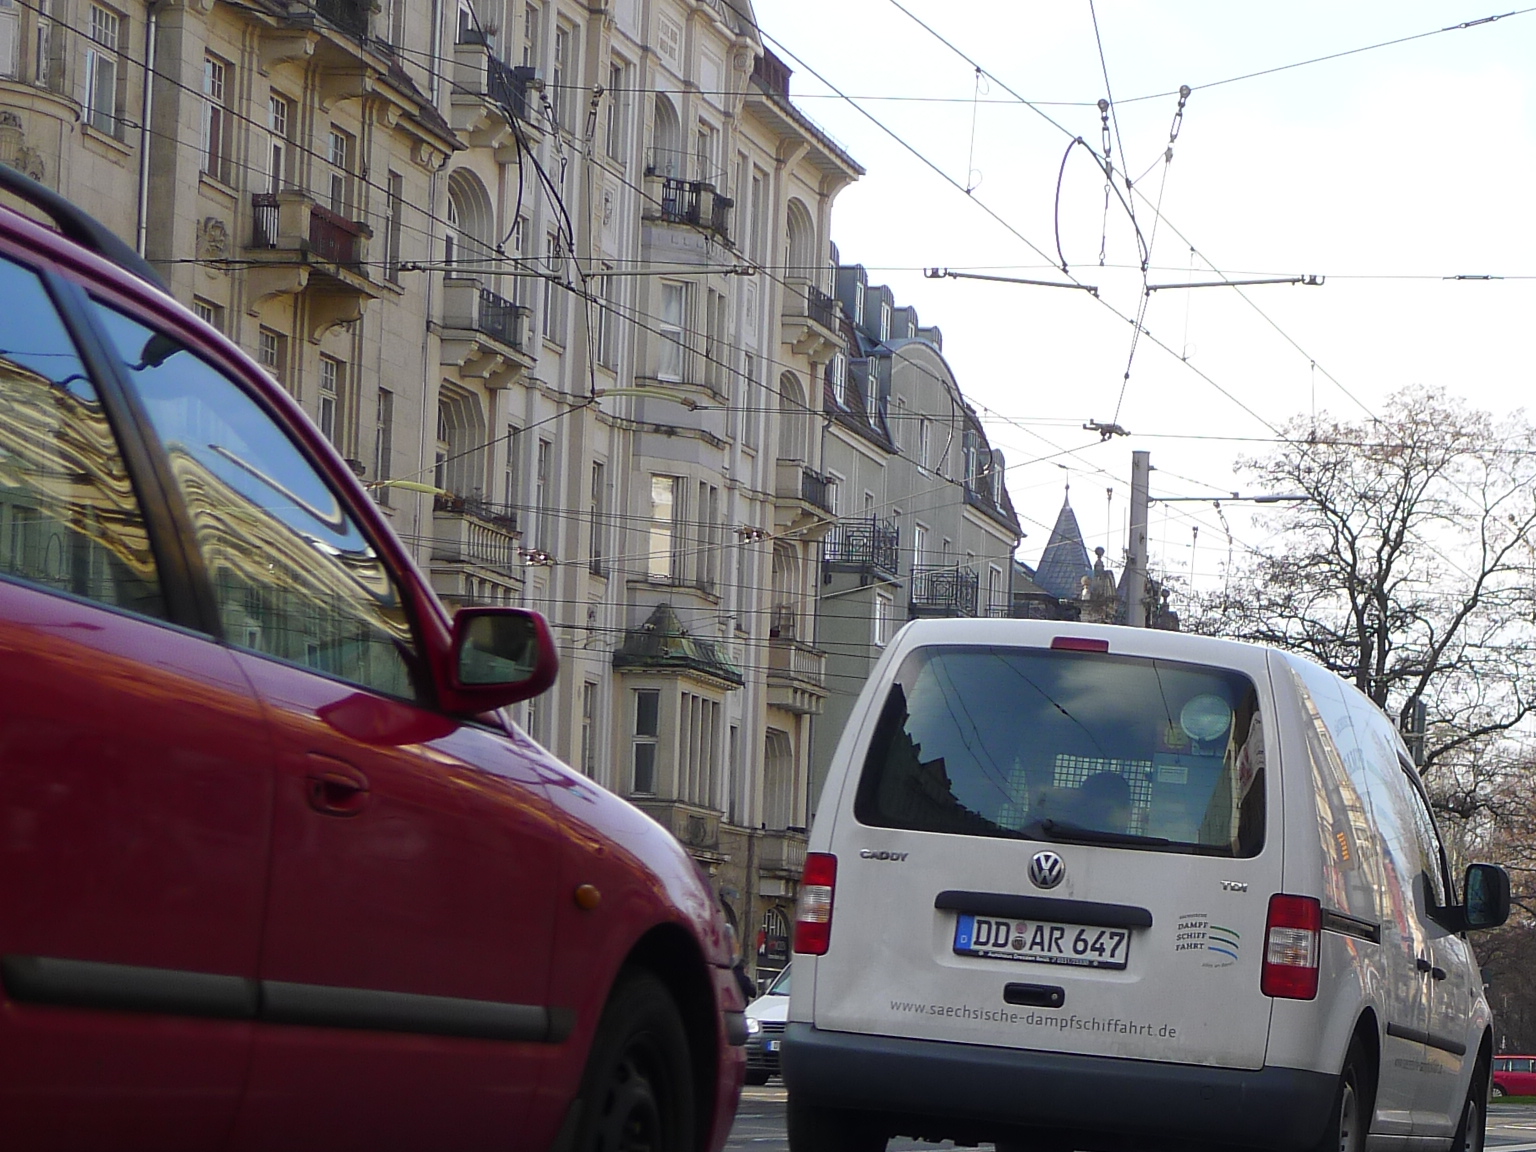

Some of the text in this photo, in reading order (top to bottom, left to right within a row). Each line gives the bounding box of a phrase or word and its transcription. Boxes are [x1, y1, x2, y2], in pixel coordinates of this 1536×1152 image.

[859, 848, 909, 862] CADDY
[1220, 880, 1248, 893] TDI
[1178, 922, 1209, 930] DAMPF
[974, 919, 1011, 948] DD
[1029, 924, 1066, 954] AR
[1072, 928, 1126, 959] 647
[1176, 932, 1207, 941] SCHIFF
[1175, 943, 1205, 951] FAHRT
[890, 1000, 1177, 1038] www.saechsische-dampfschiffahrt.de
